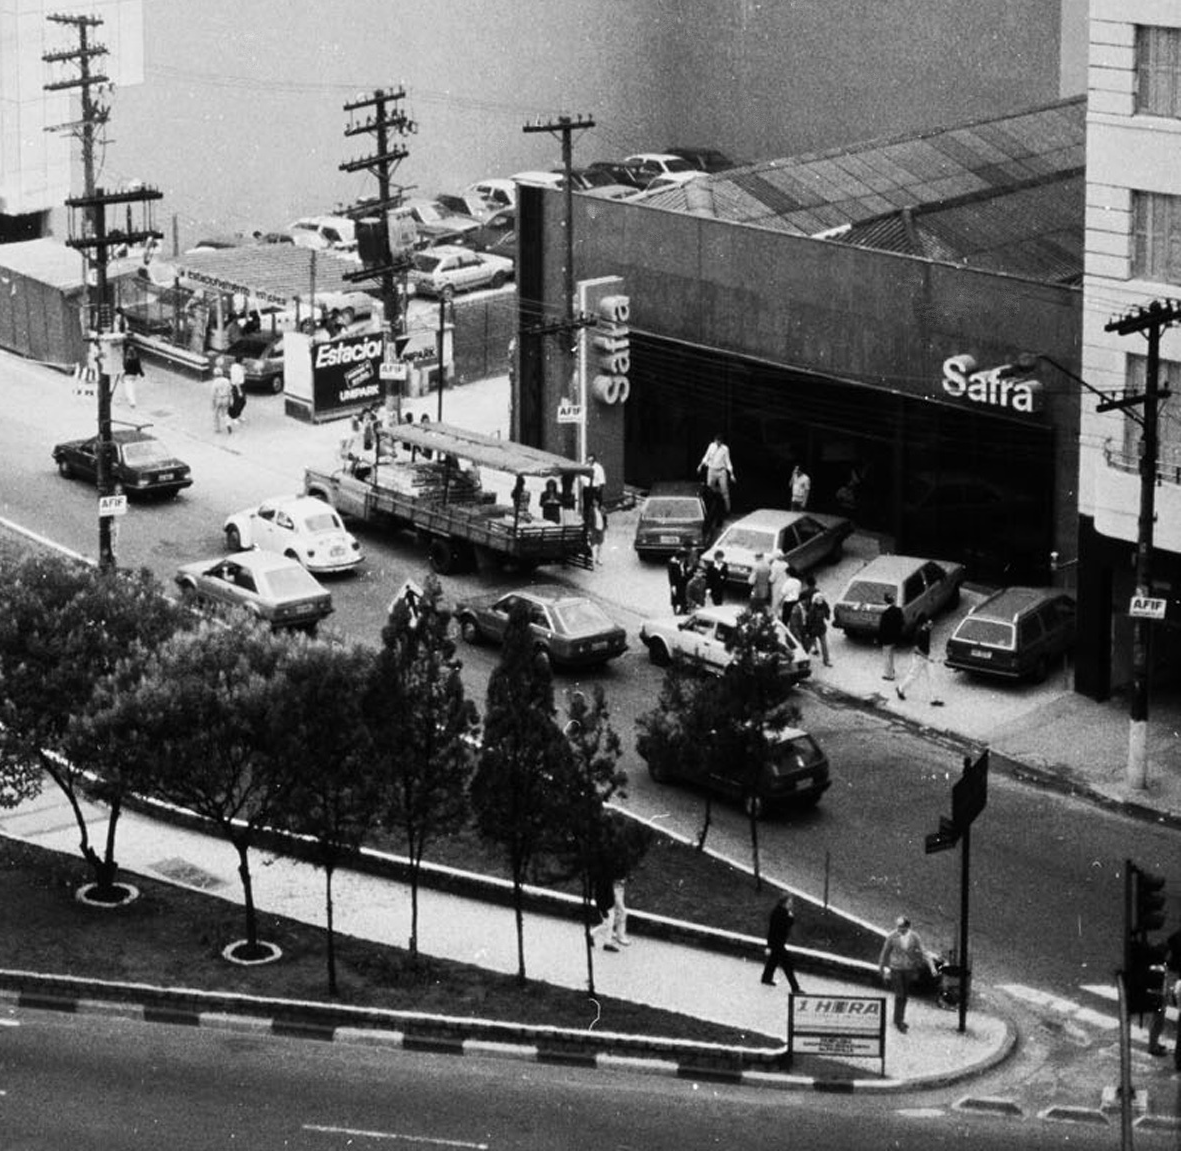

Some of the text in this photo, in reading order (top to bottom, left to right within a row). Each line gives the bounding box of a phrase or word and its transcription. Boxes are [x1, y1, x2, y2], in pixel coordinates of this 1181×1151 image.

[595, 295, 631, 405] Safra
[941, 354, 1038, 413] Safra
[1133, 599, 1163, 611] AFIF
[797, 1000, 809, 1012] 1
